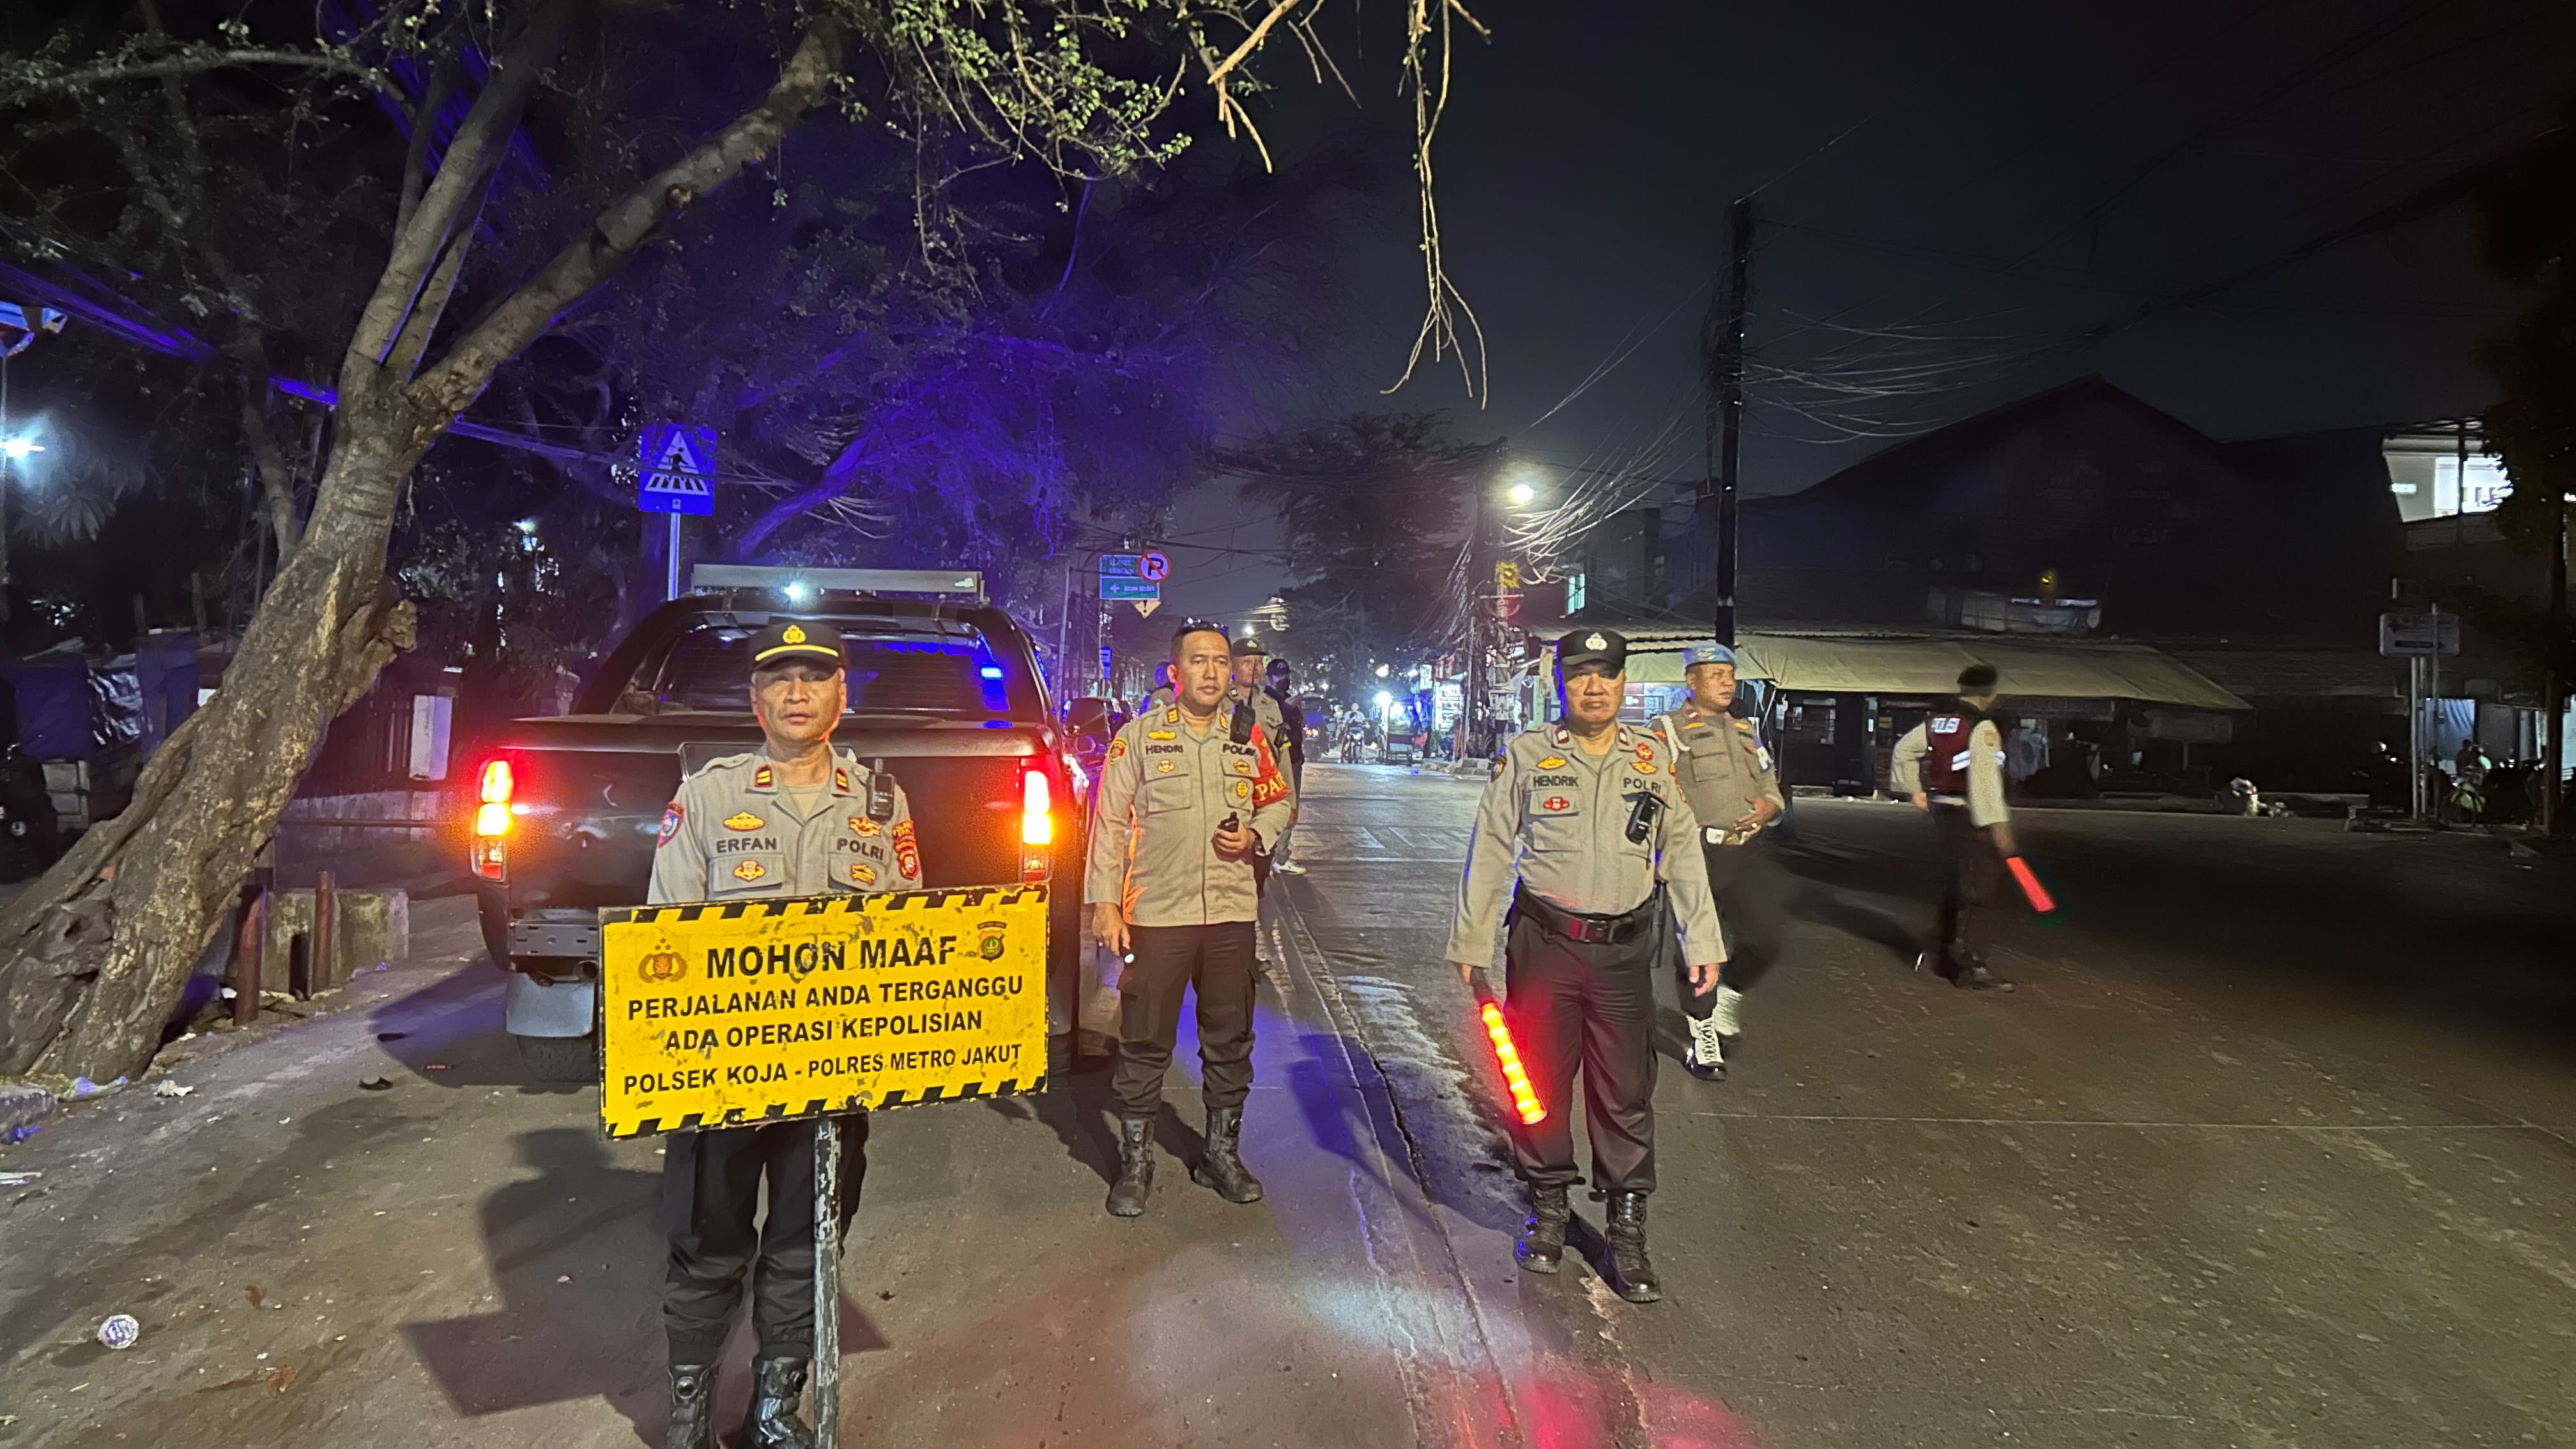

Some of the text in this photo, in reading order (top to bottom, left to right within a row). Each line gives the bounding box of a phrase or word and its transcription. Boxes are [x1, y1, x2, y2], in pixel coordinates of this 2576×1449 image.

[1146, 744, 1183, 755] HENDRI
[1533, 776, 1579, 788] HENDRIK
[1623, 778, 1661, 792] POLRI
[716, 838, 777, 854] ERFAN
[837, 838, 884, 861] POLRI
[707, 935, 958, 979] MOHON MAAF
[628, 976, 1023, 1020] PERJALANAN ANDA TERGANGGU
[665, 1010, 982, 1052] ADA OPERASI KEPOLISIAN
[624, 1068, 717, 1094] POLSEK
[727, 1062, 787, 1085] KOJA
[808, 1054, 884, 1078] POLRES
[890, 1049, 955, 1071] METRO
[961, 1044, 1022, 1066] JAKUT
